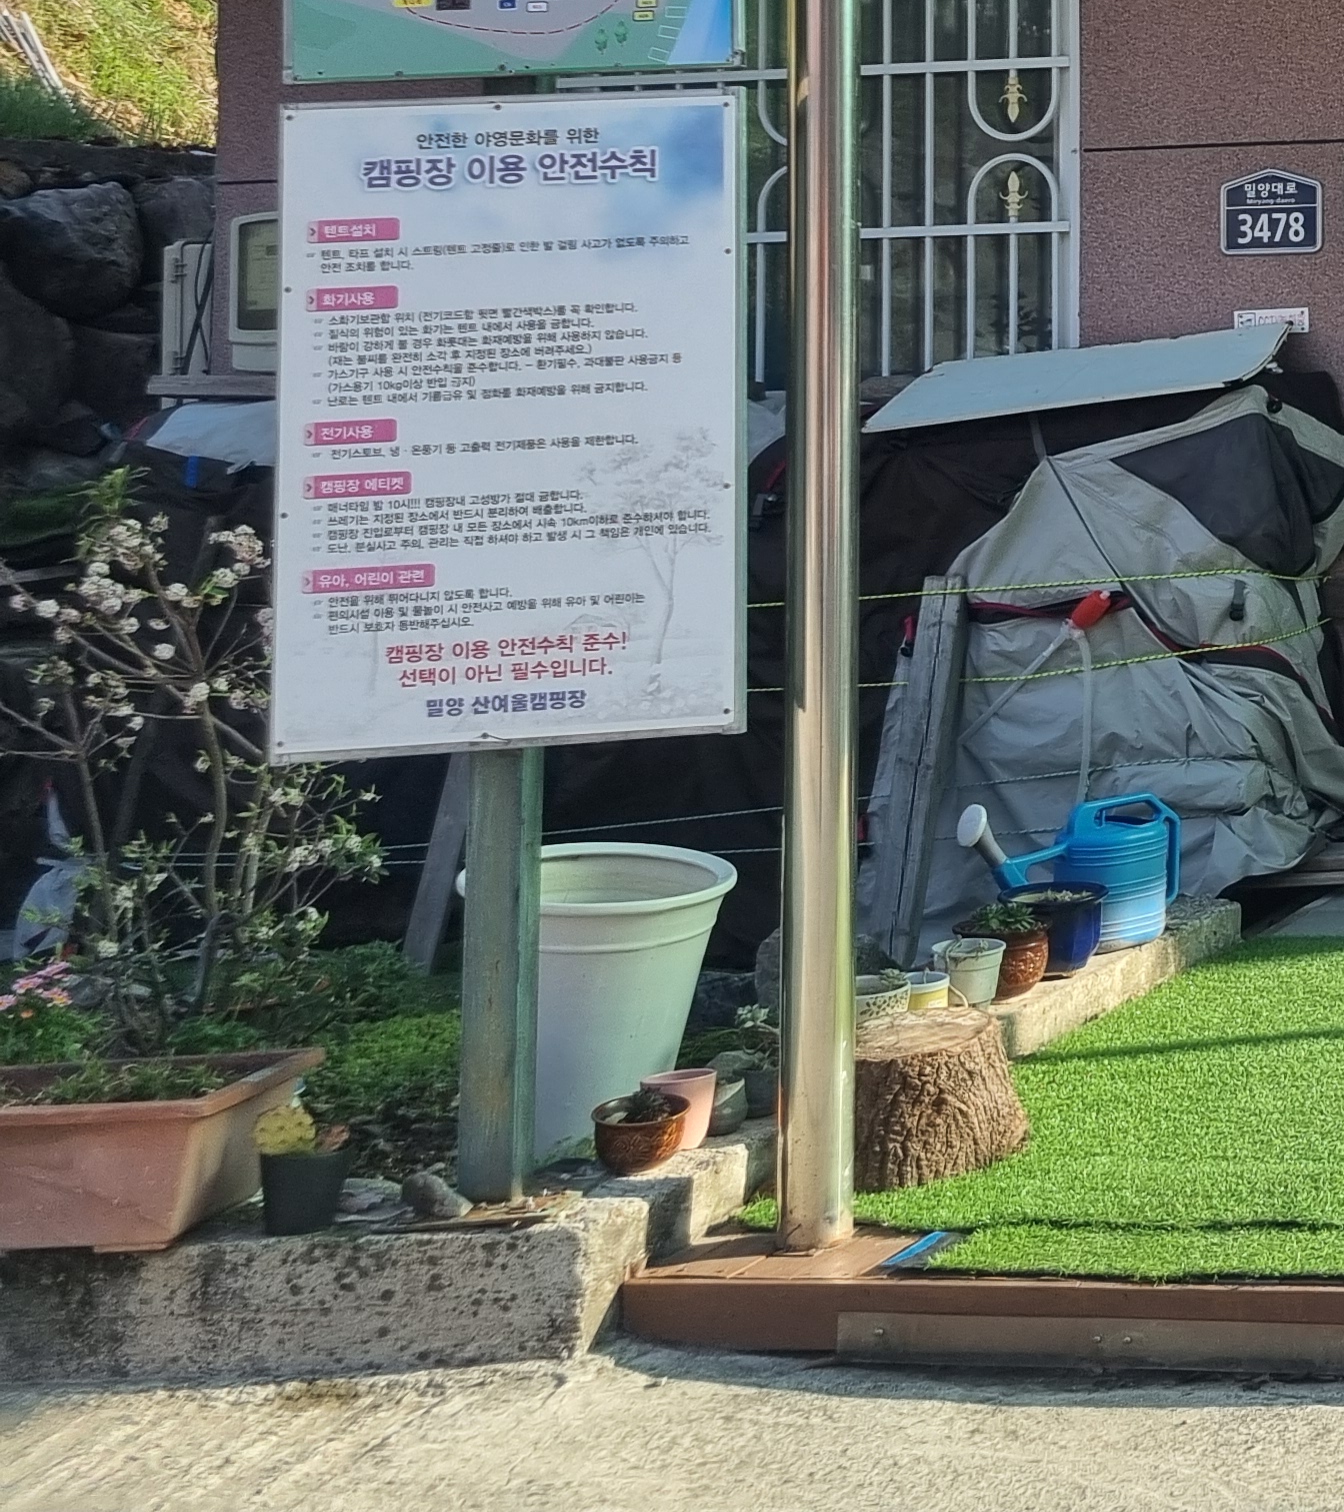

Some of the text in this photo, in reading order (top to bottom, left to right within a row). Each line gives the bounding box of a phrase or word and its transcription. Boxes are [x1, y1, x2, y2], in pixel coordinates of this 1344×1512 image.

[416, 127, 599, 150] 안전한 야영문화를 위한
[362, 148, 657, 190] 캠핑장 이용 안전수칙
[1244, 182, 1298, 198] 밀양대로
[323, 223, 375, 238] 텐트설치
[1237, 211, 1306, 245] 3478
[322, 291, 374, 307] 화기사용
[320, 424, 373, 441] 전기사용
[320, 476, 403, 494] 캠핑장 에티켓
[318, 569, 424, 588] 유아, 어린이 관련
[385, 630, 629, 665] 캠핑장 이용 안전수칙 준수!
[398, 655, 612, 688] 선택이 아닌 필수입니다.
[426, 689, 587, 718] 밀양 산여울캠핑장
